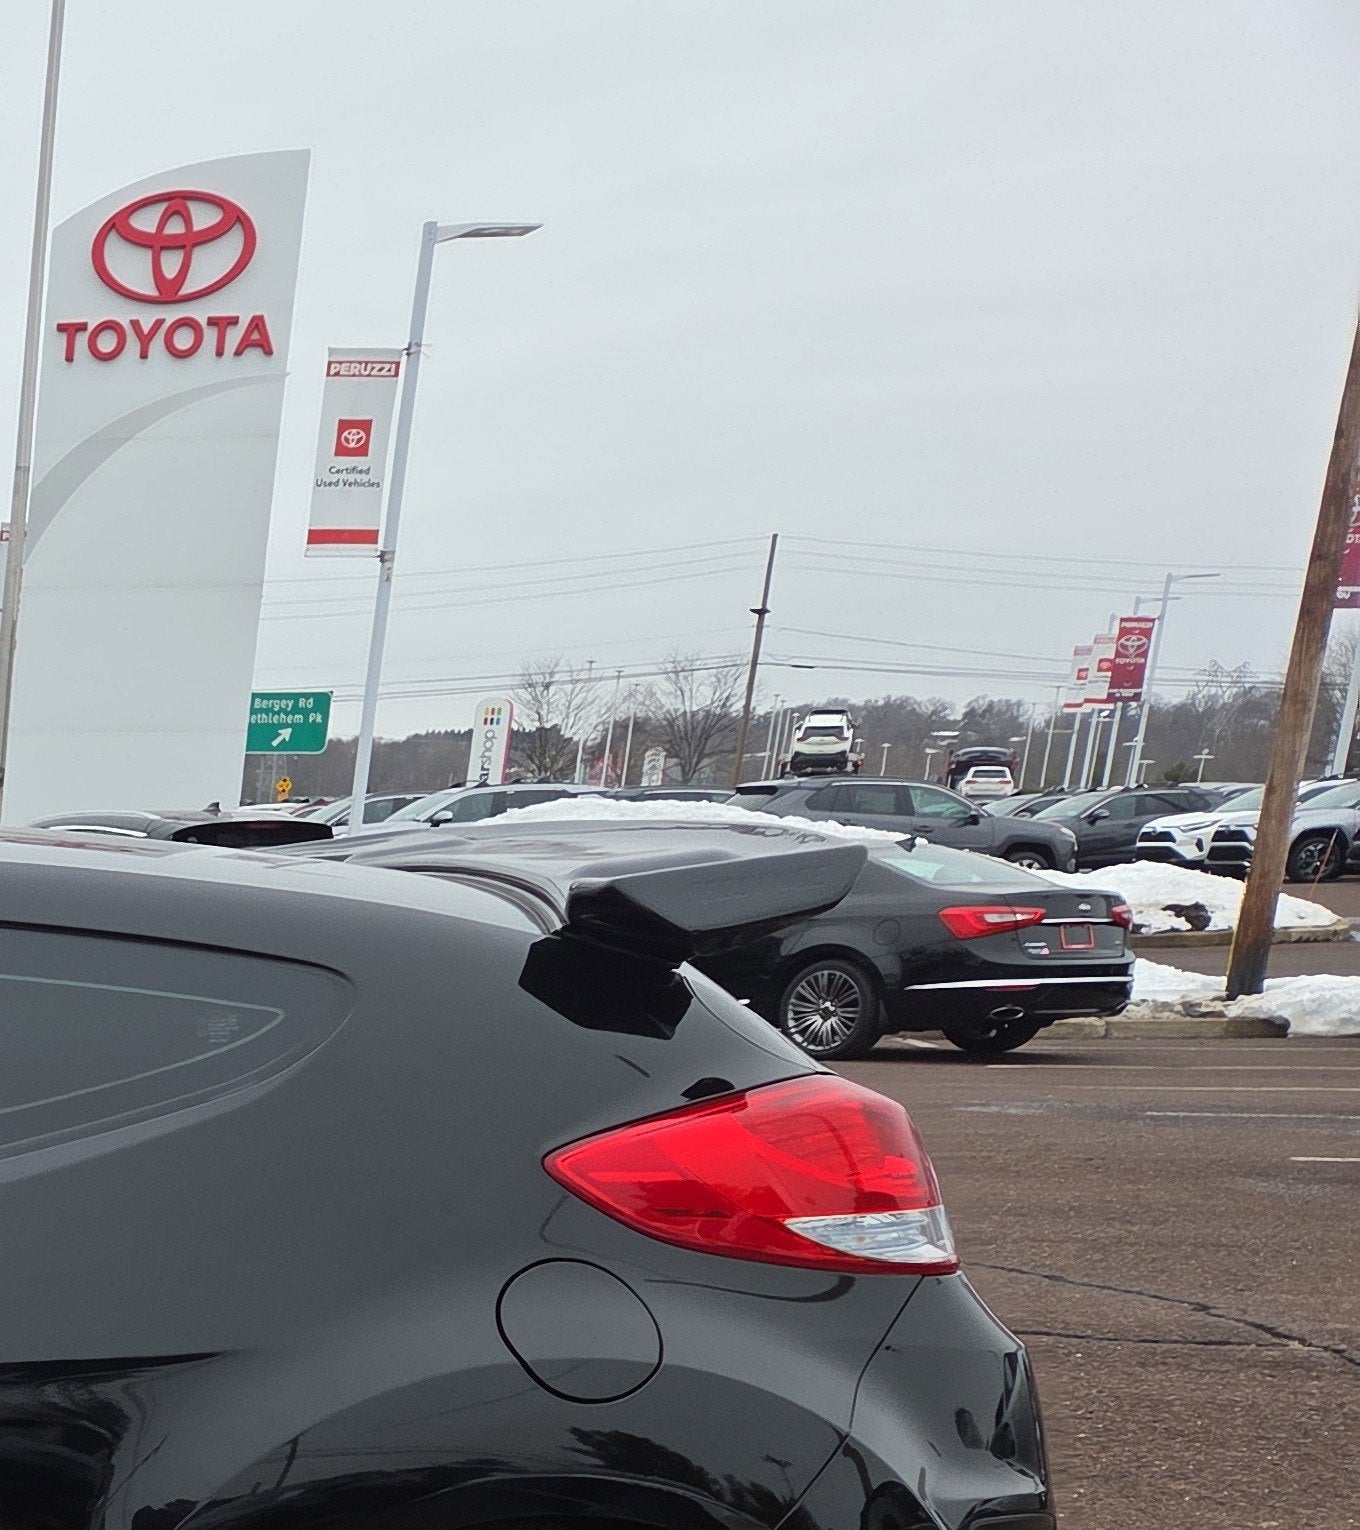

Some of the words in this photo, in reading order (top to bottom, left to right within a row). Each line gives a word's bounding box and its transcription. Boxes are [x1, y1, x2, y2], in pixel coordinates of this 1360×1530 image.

[56, 314, 274, 363] TOYOTA
[329, 362, 396, 376] PERUZZI
[328, 466, 371, 476] Certified
[315, 478, 340, 488] Used
[342, 478, 381, 489] Vehicles
[253, 697, 295, 712] Bergey
[298, 697, 314, 709] Rd
[250, 711, 304, 724] ethlehem
[308, 711, 323, 724] Pk
[479, 728, 499, 782] arshop
